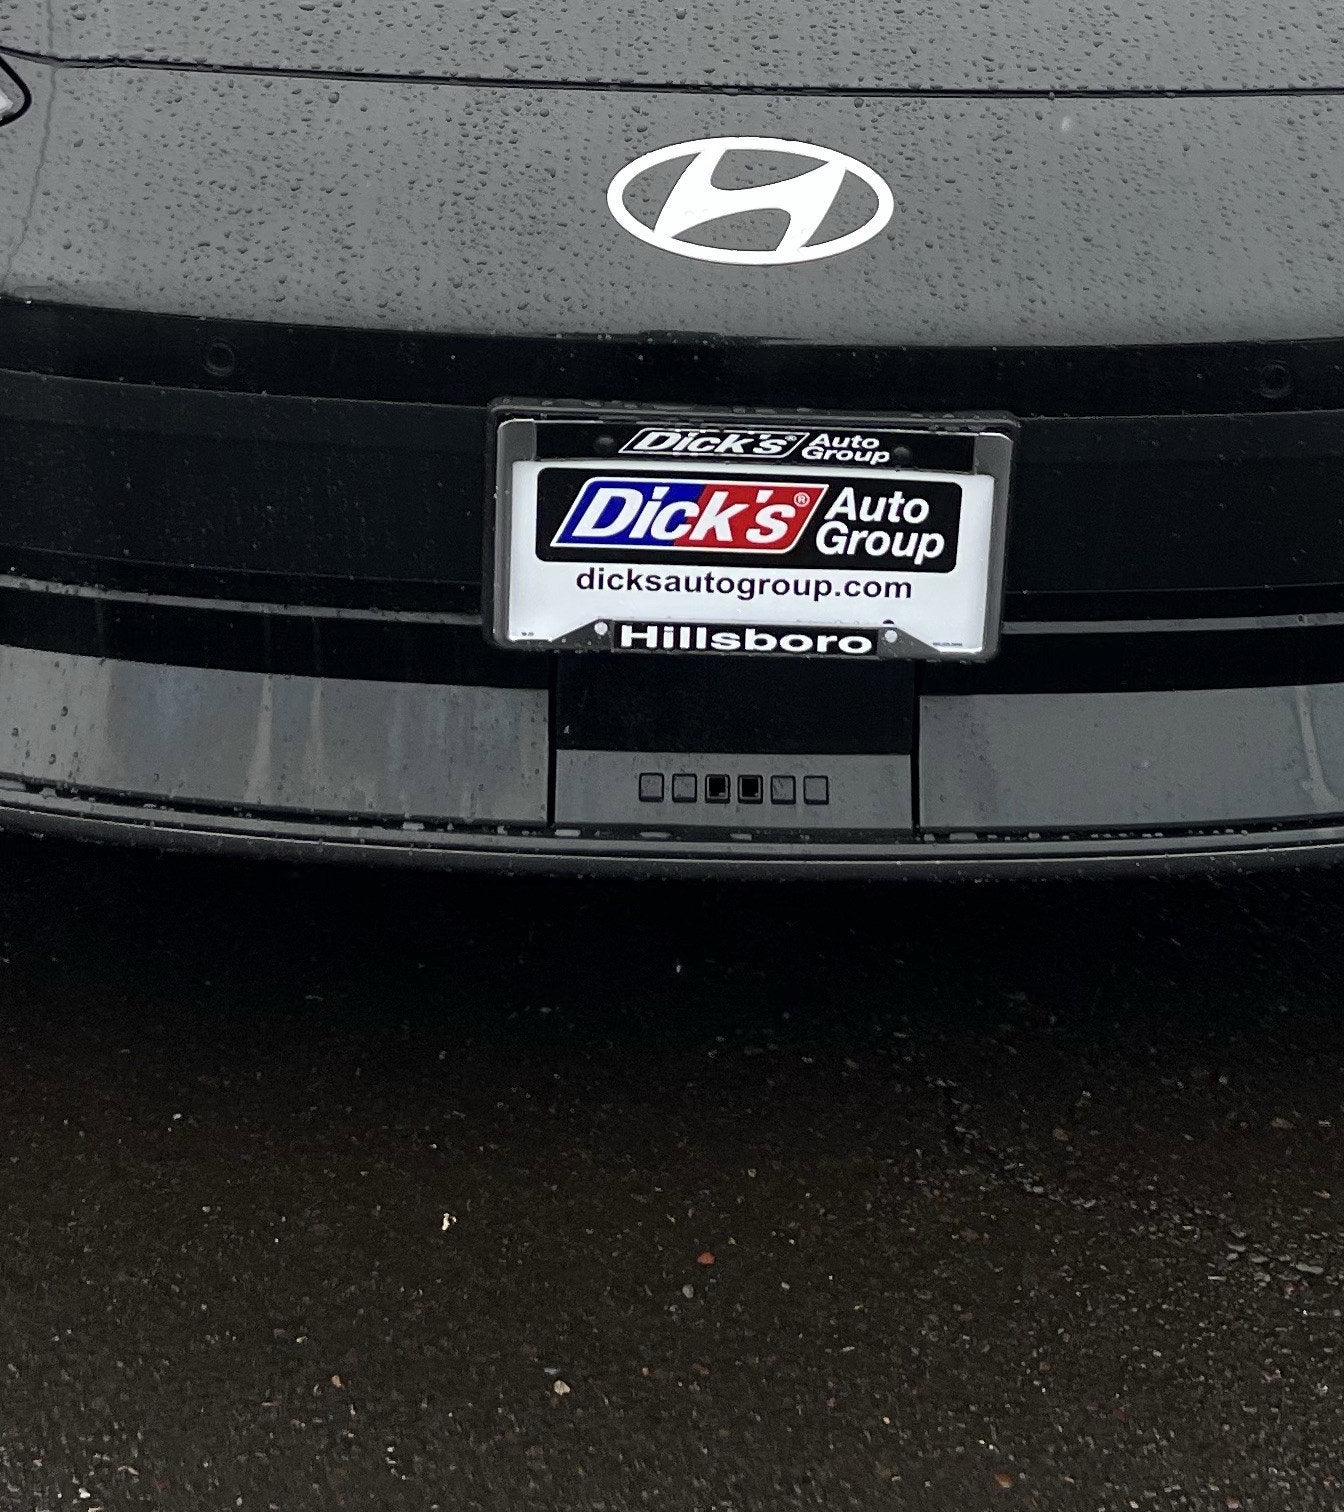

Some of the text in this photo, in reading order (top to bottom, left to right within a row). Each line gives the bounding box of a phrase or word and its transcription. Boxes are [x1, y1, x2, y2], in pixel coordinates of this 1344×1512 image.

[801, 445, 890, 465] Group
[808, 433, 880, 450] Auto
[824, 487, 930, 524] Auto
[815, 521, 945, 565] Group
[576, 568, 913, 601] dicksautogroup.com
[619, 624, 873, 655] Hillsboro
